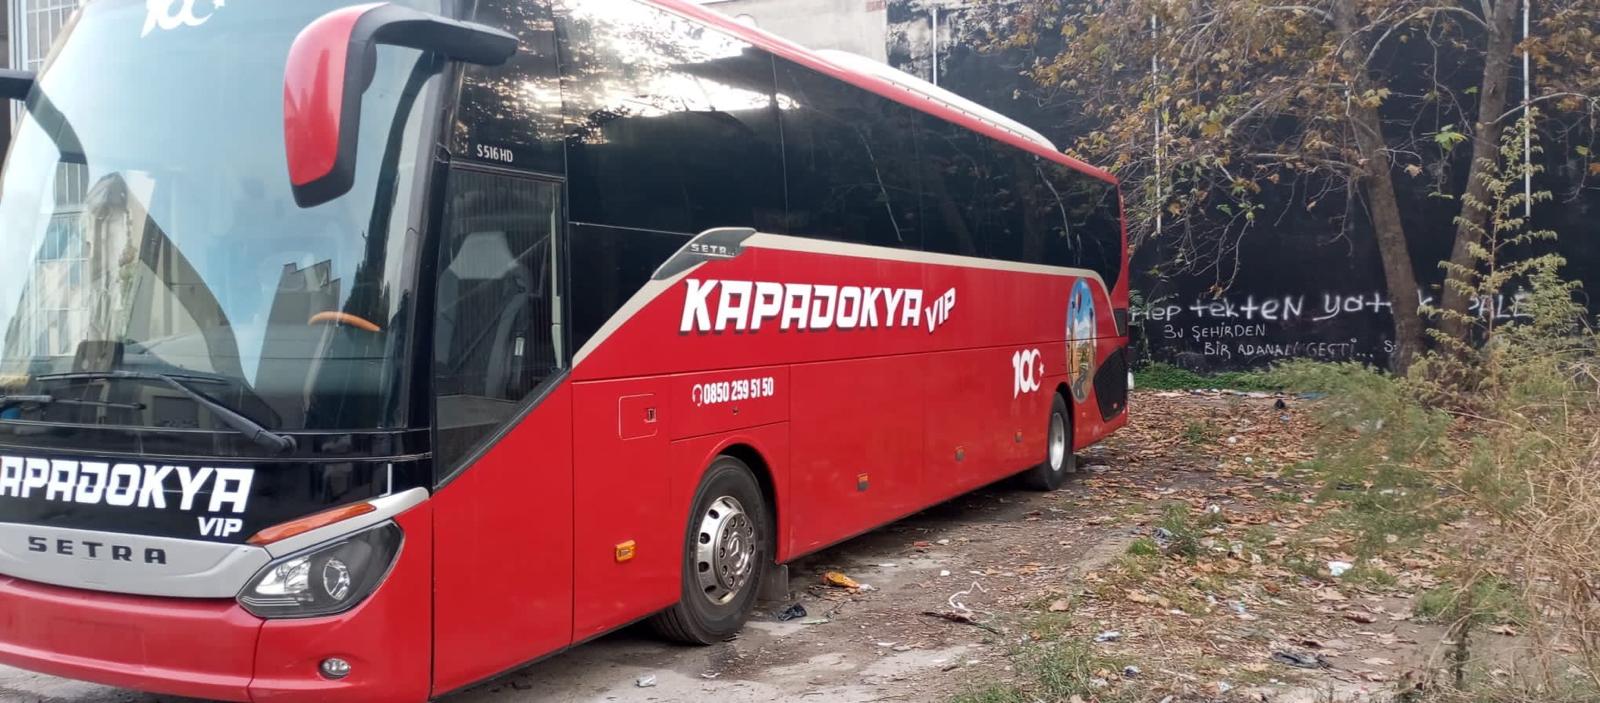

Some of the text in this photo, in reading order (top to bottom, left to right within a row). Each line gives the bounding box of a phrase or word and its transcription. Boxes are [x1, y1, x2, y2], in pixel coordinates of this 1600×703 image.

[476, 143, 513, 163] S 516 HD
[680, 278, 956, 334] KAPADOKYA VIP
[704, 376, 774, 405] 0850 259 51 50
[197, 516, 243, 537] VIP
[28, 535, 167, 565] SETRA
